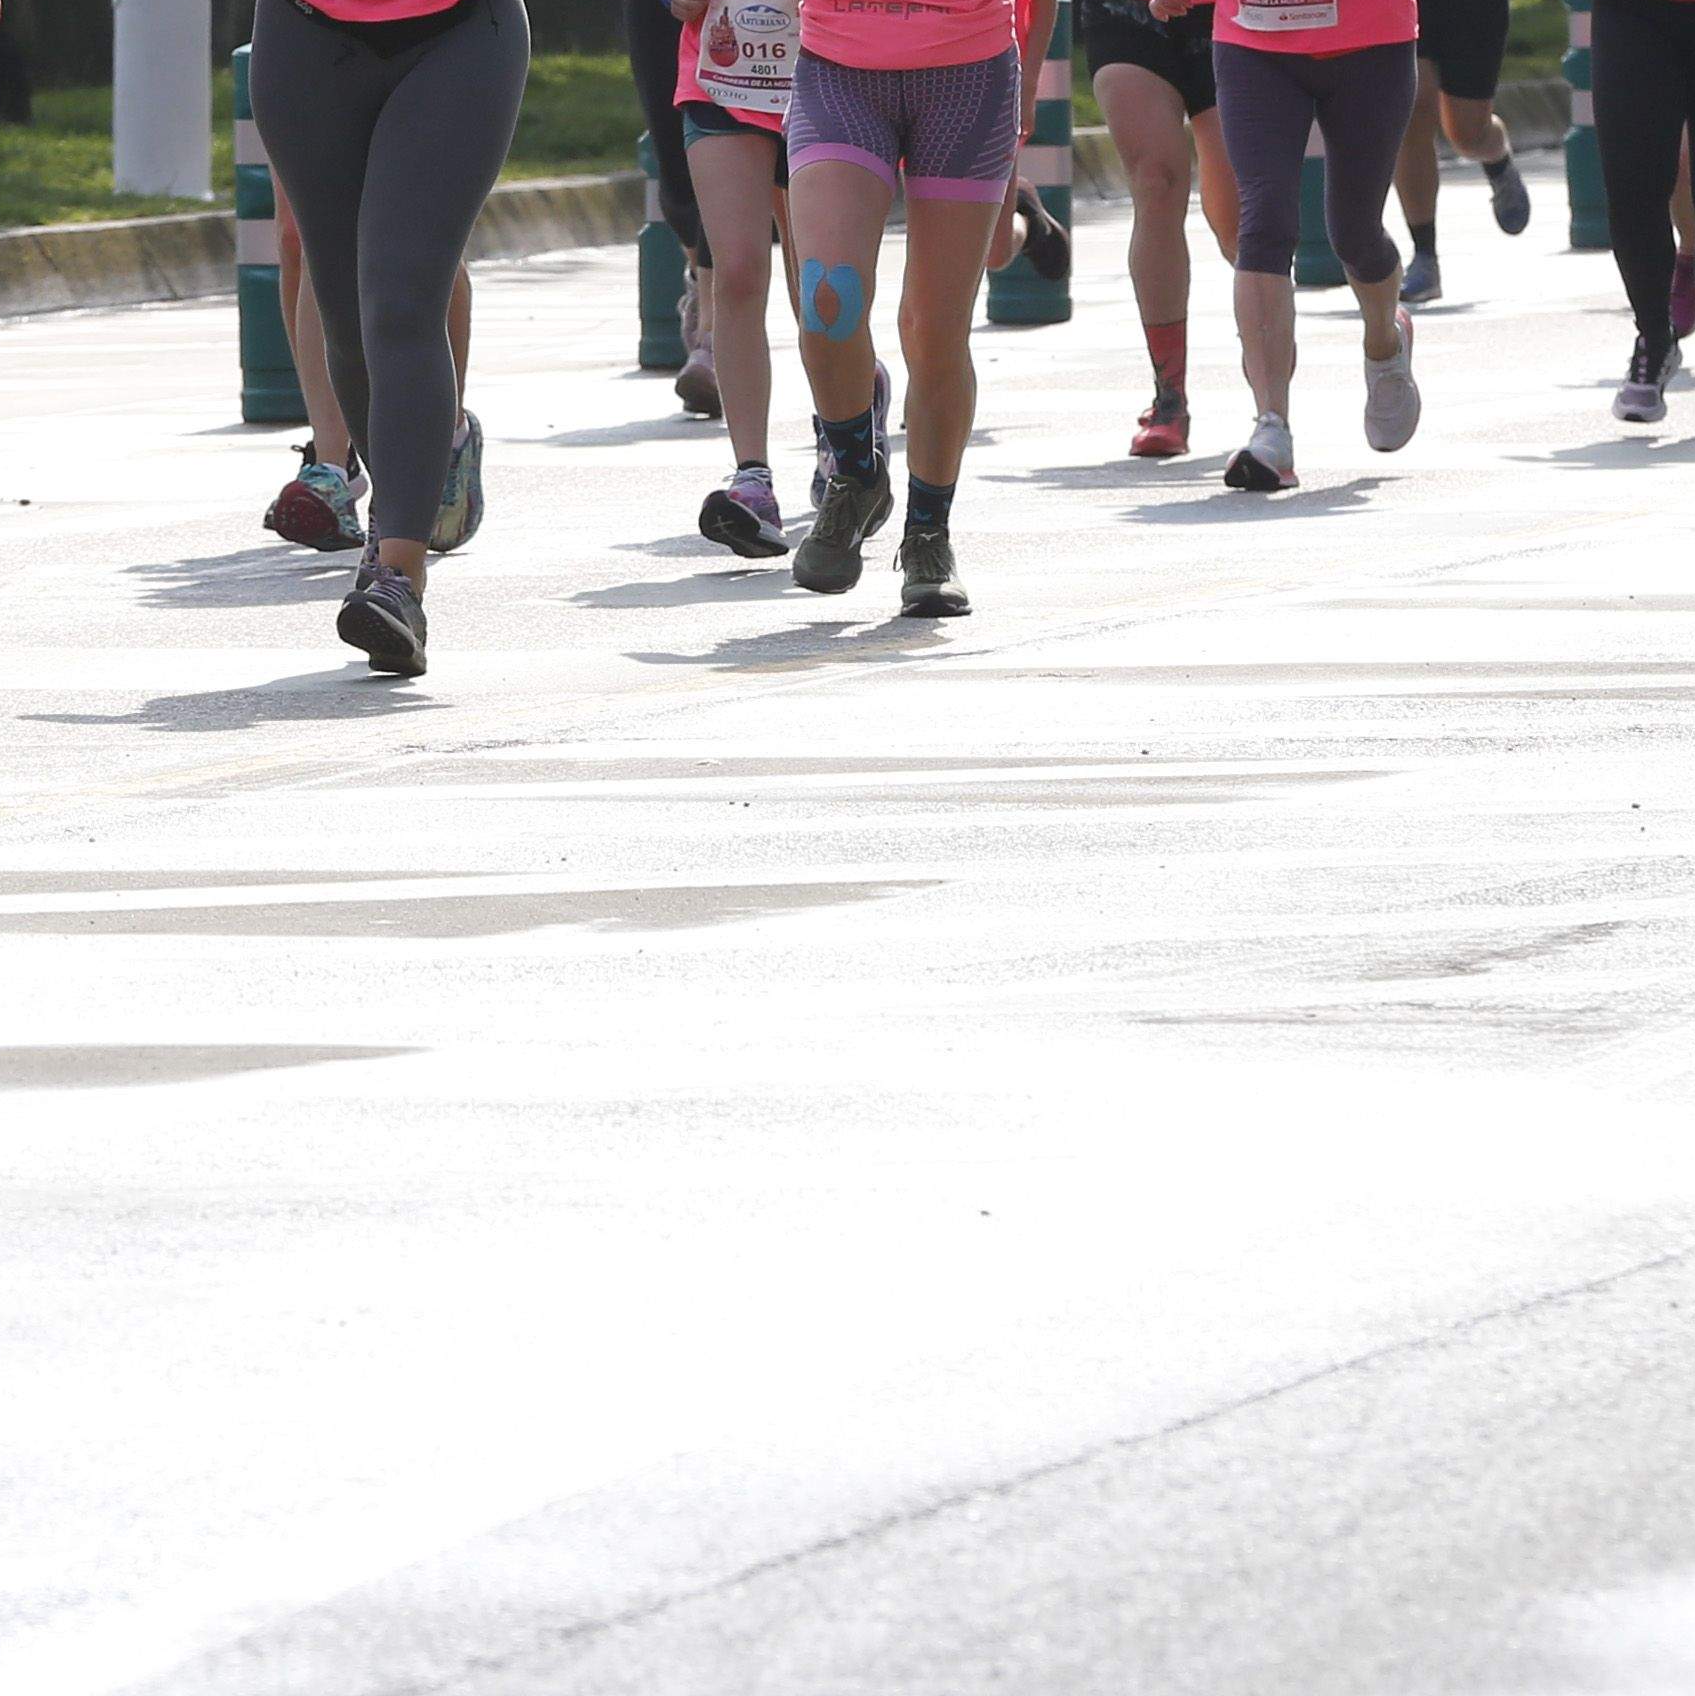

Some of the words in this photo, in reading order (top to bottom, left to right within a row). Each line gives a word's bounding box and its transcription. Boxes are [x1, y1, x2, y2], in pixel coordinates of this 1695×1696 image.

[739, 13, 786, 27] ASTURIANA
[741, 42, 786, 59] 016
[750, 65, 778, 75] 4801
[712, 73, 750, 86] CARRERA
[750, 79, 763, 87] DE
[763, 80, 774, 88] LA
[706, 86, 749, 102] OYSHO
